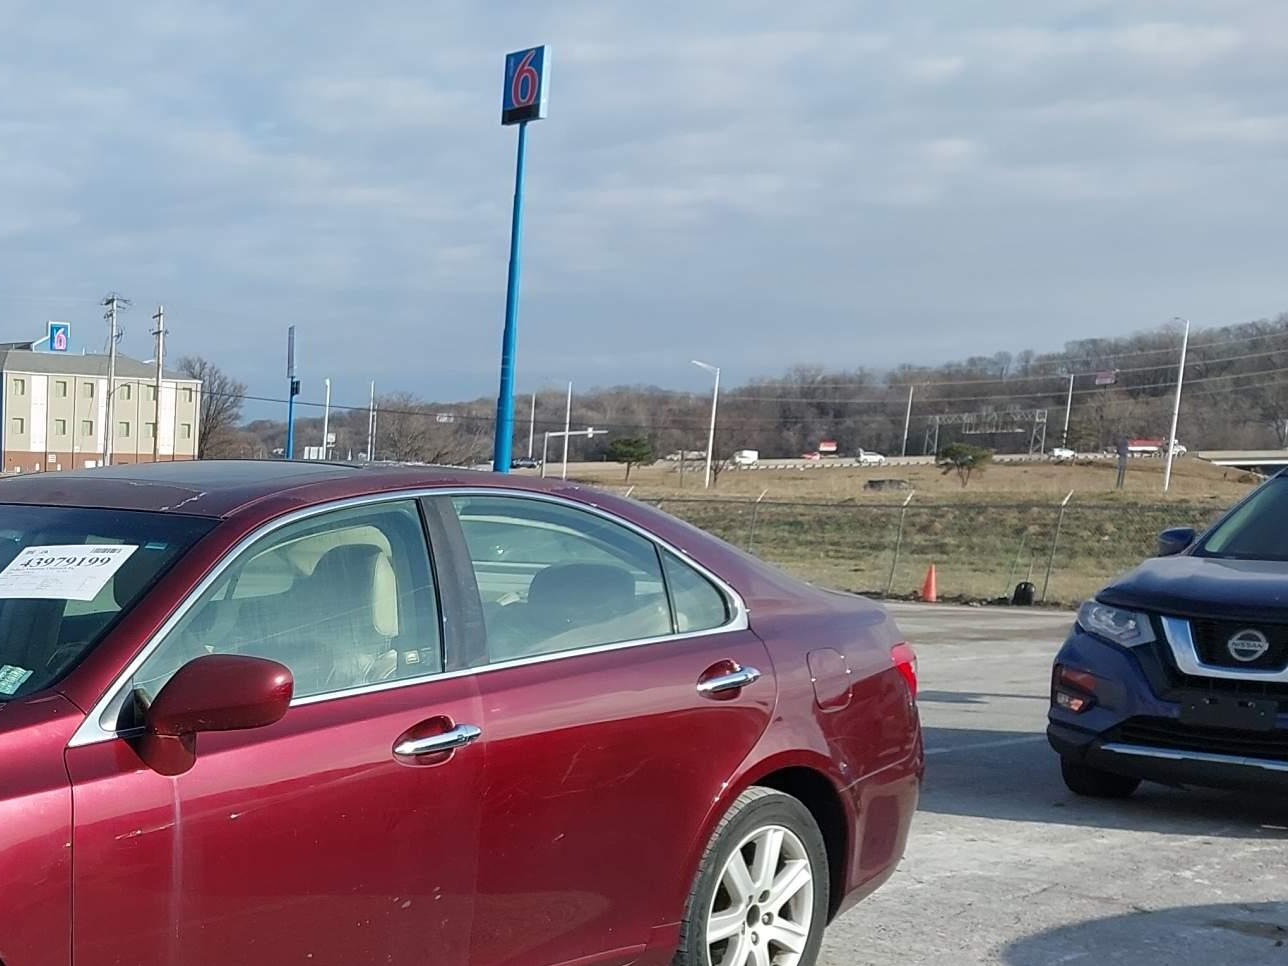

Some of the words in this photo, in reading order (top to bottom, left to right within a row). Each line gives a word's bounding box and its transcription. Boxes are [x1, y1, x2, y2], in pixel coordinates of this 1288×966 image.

[512, 49, 538, 107] 6
[54, 327, 67, 350] 6
[19, 556, 112, 568] 43979199
[1231, 641, 1265, 650] NISSAN
